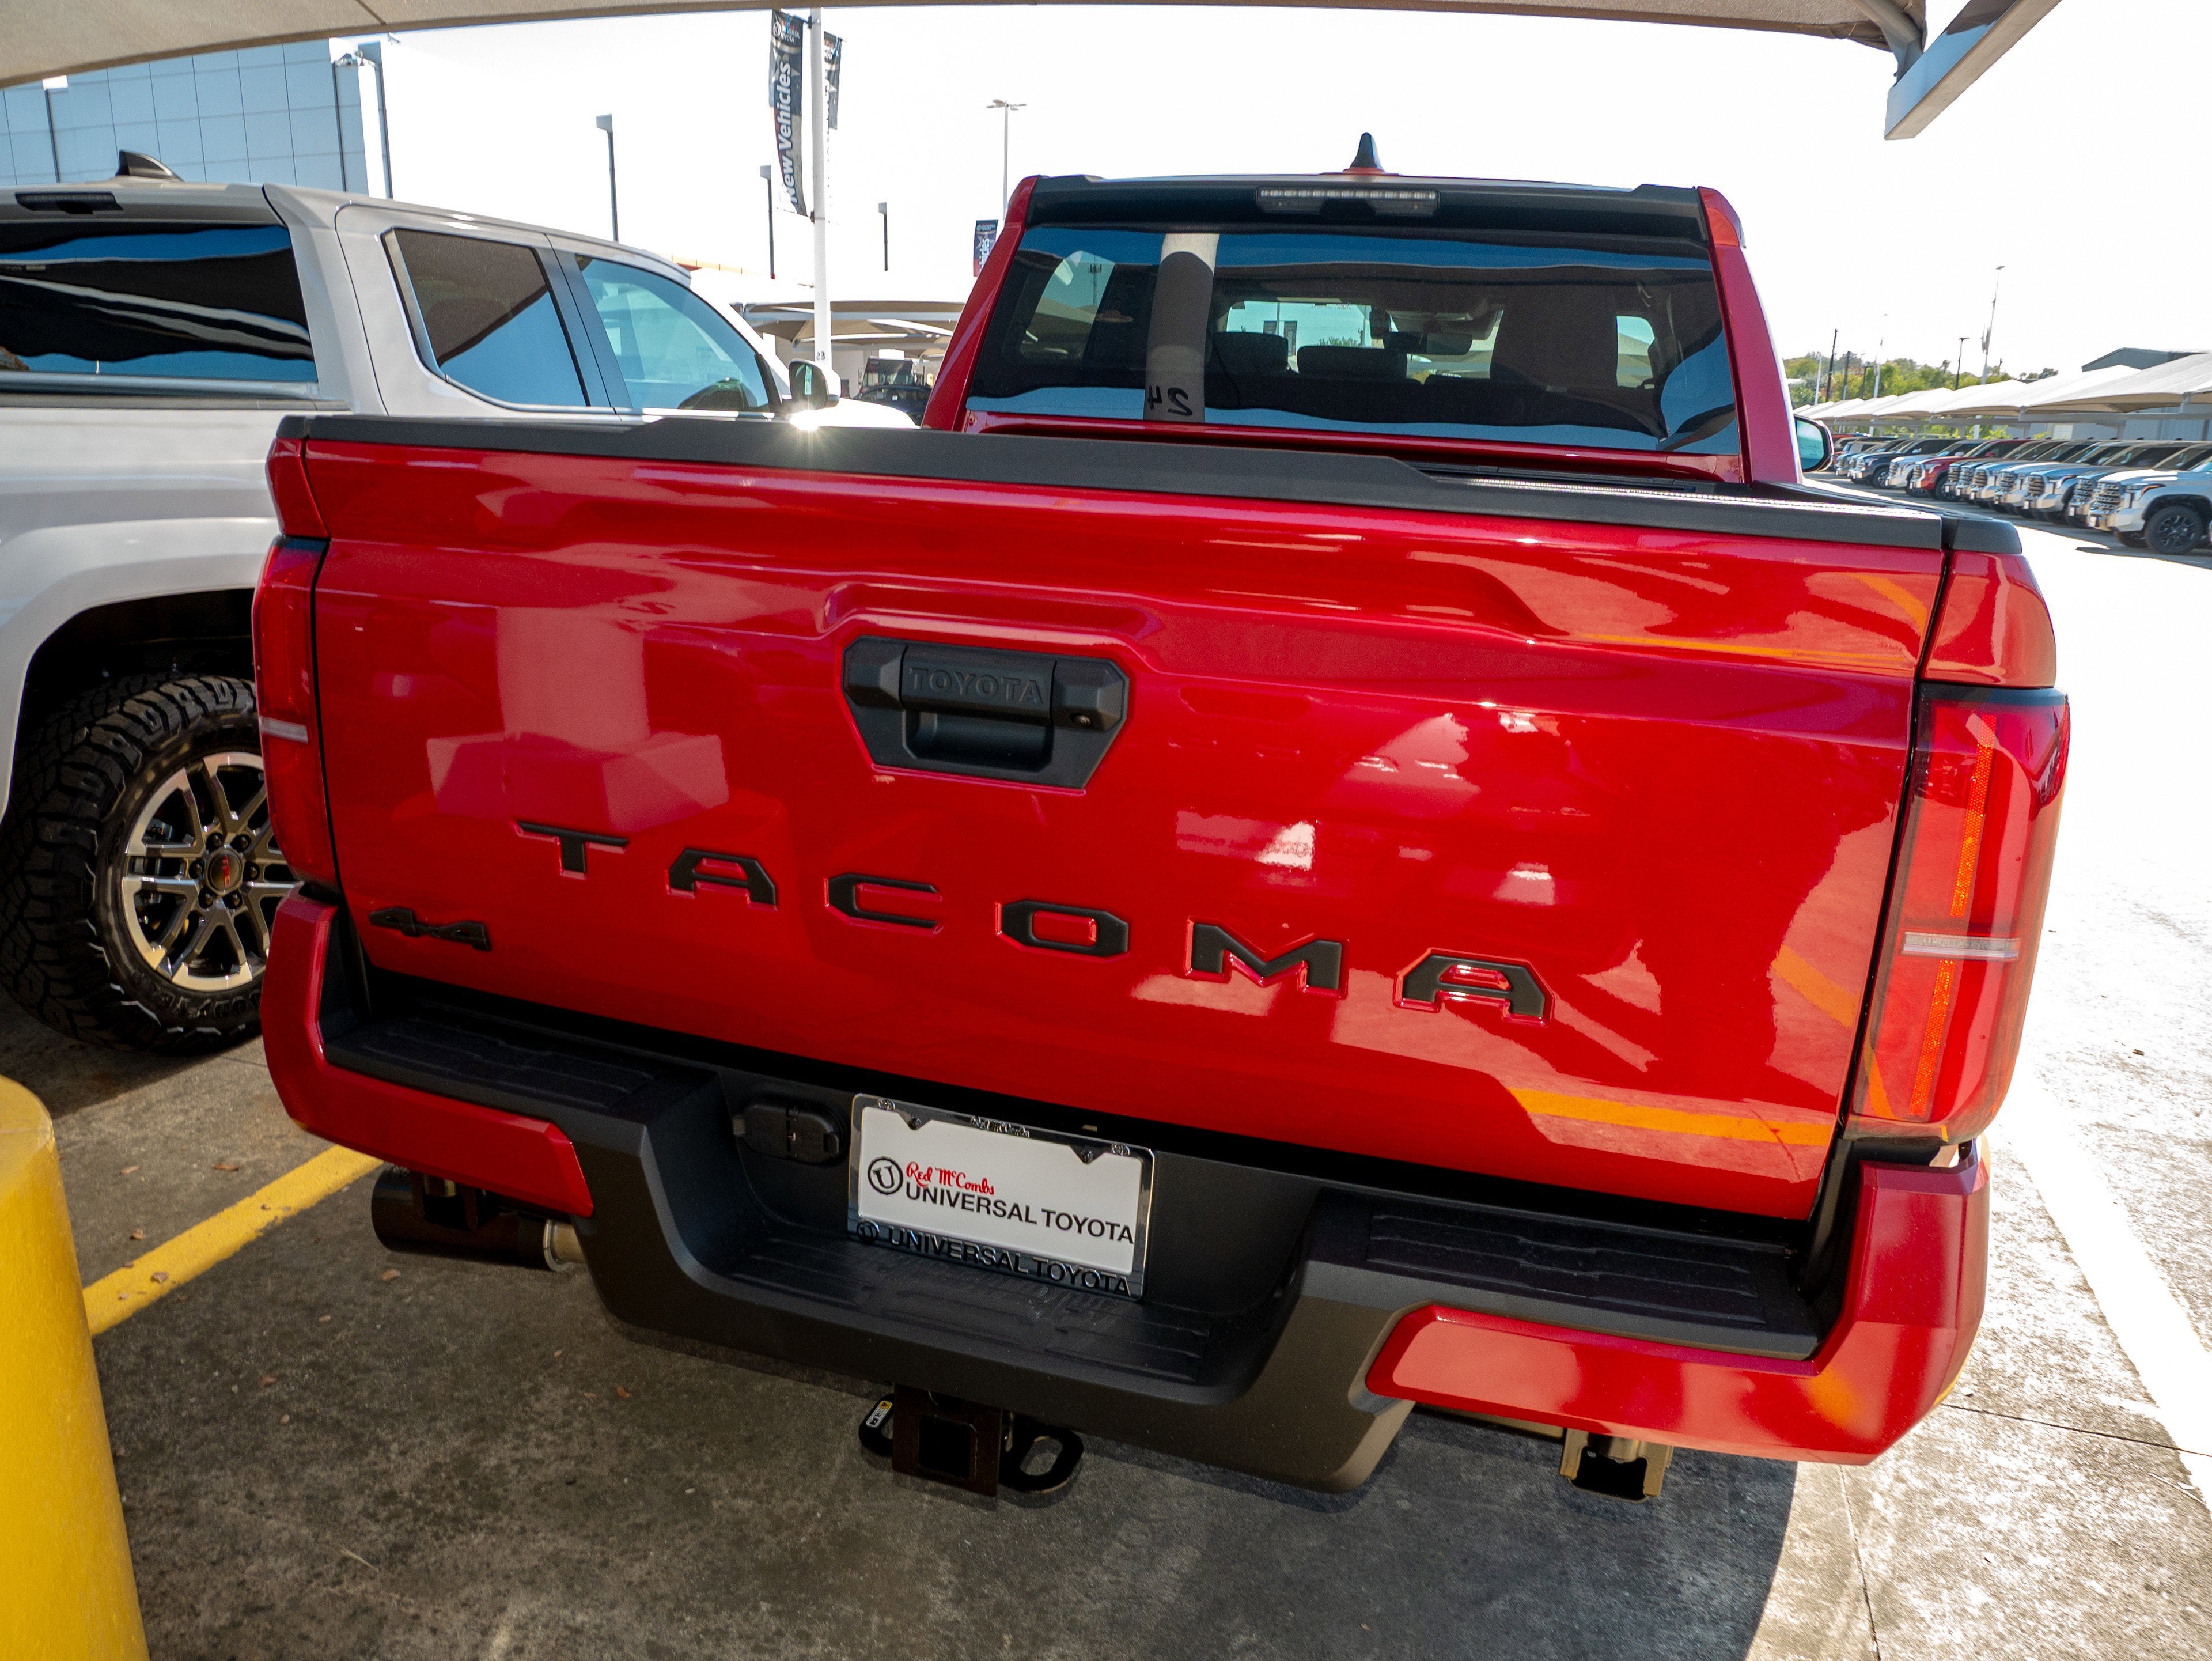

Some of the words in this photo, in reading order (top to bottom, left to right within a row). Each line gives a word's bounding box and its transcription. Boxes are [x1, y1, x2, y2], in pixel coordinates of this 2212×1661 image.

[777, 61, 793, 150] Vehicles
[909, 666, 1044, 704] TOYOTA
[516, 820, 1550, 1022] TACOMA
[906, 1161, 933, 1187] Red
[935, 1167, 995, 1195] McCombs
[906, 1181, 1037, 1225] UNIVERSAL
[1041, 1208, 1134, 1244] TOYOTA
[889, 1226, 1029, 1274] UNIVERSAL
[1032, 1257, 1131, 1298] TOYOTA
